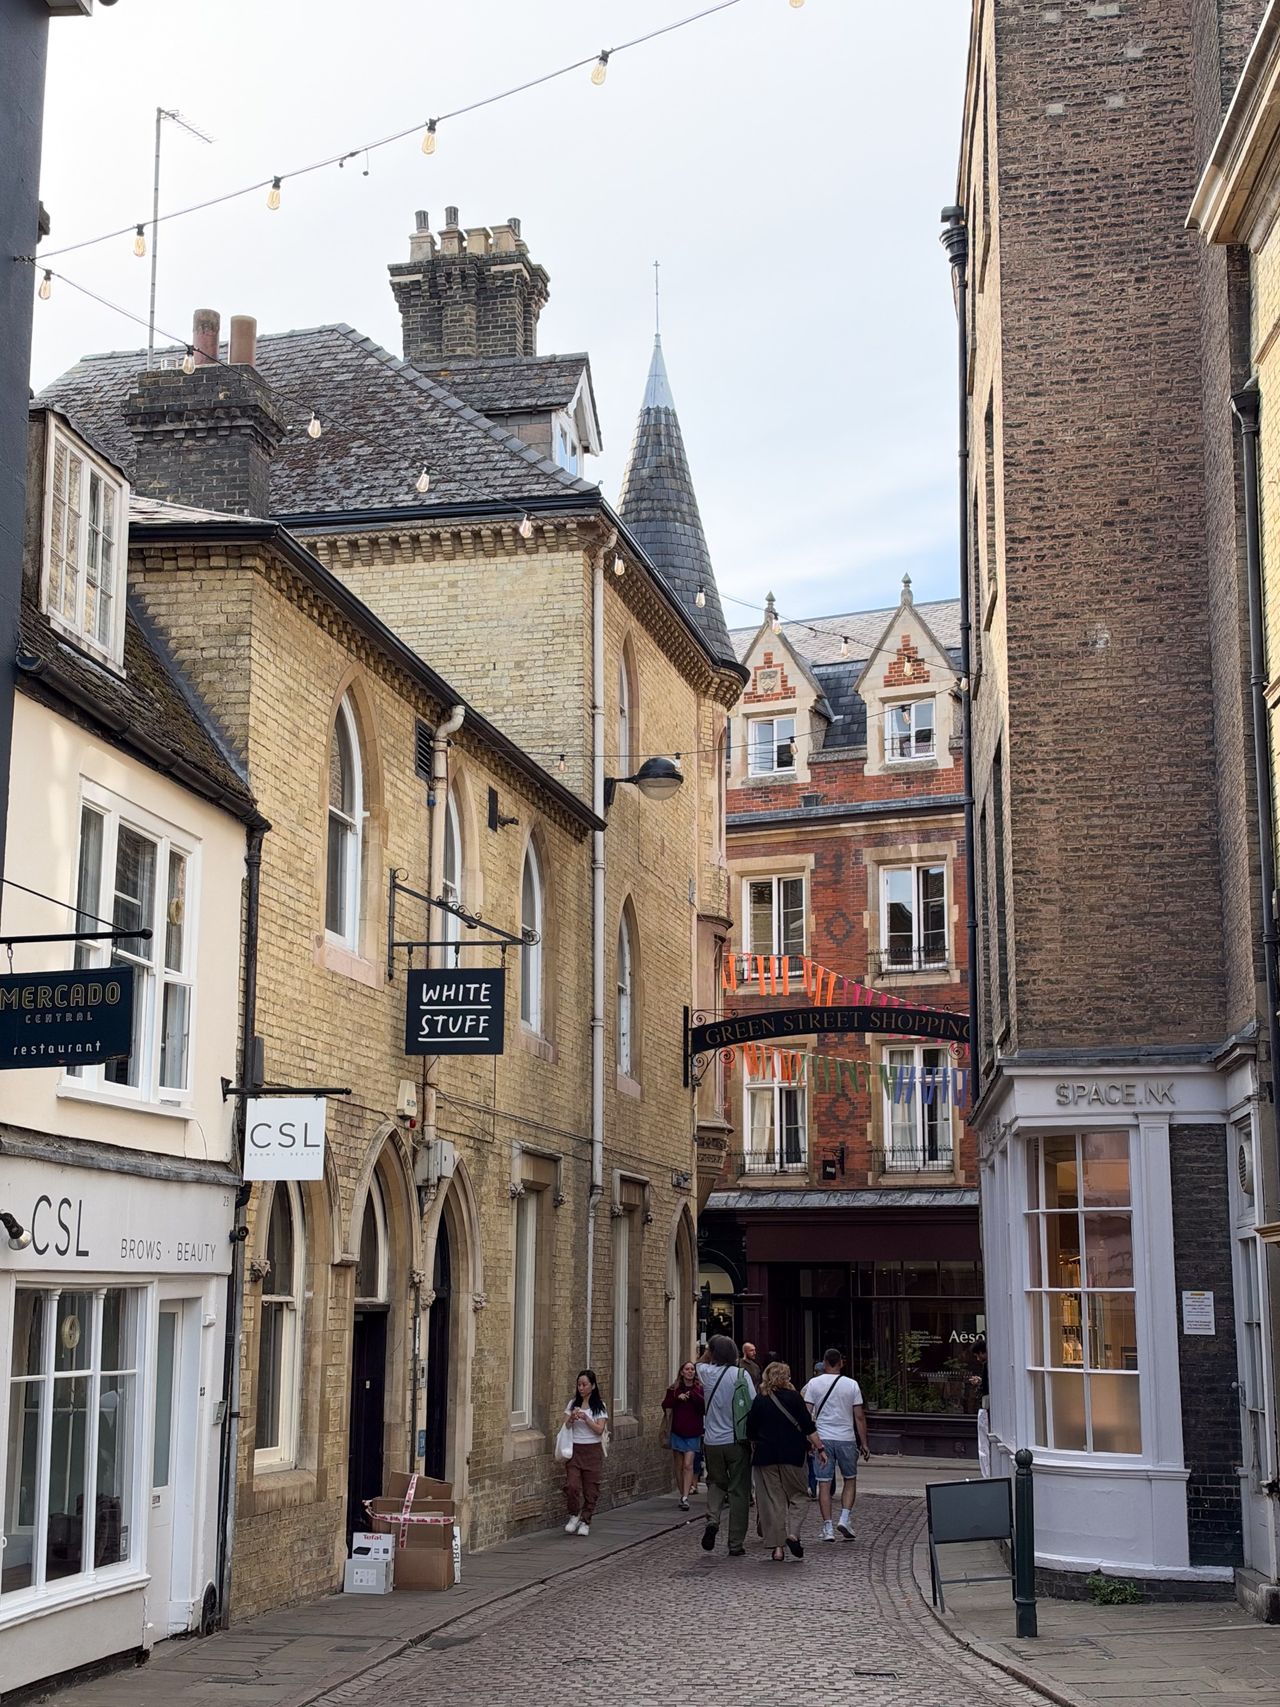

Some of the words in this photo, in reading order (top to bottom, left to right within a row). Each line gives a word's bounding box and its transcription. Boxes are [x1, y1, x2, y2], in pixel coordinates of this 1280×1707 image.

[0, 982, 120, 1011] MERCADO
[422, 983, 491, 1003] WHITE
[25, 1012, 93, 1024] CENTRAL
[419, 1014, 490, 1035] STUFF
[705, 1018, 776, 1045] GREEN
[783, 1011, 863, 1032] STREET
[13, 1040, 101, 1056] restaurant
[1056, 1082, 1176, 1105] SPACE.NK
[250, 1122, 321, 1149] CSL
[32, 1195, 89, 1257] CSL
[120, 1238, 162, 1260] BROWS
[177, 1242, 217, 1262] BEAUTY
